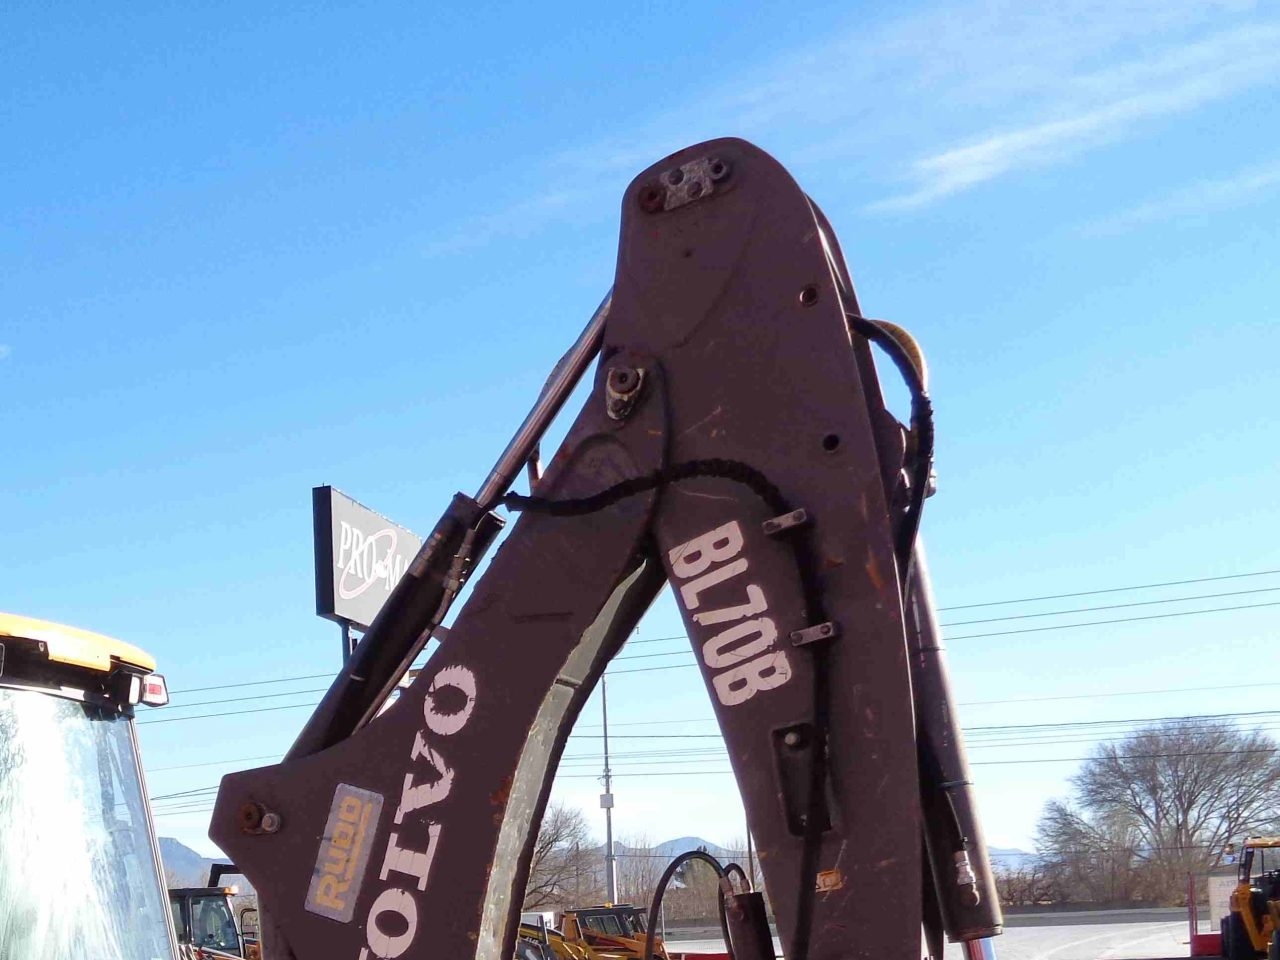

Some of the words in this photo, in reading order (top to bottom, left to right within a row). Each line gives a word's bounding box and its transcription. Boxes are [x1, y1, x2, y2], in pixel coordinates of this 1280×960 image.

[337, 520, 377, 583] PRO
[668, 520, 792, 706] BL70B
[315, 795, 364, 911] RUDD
